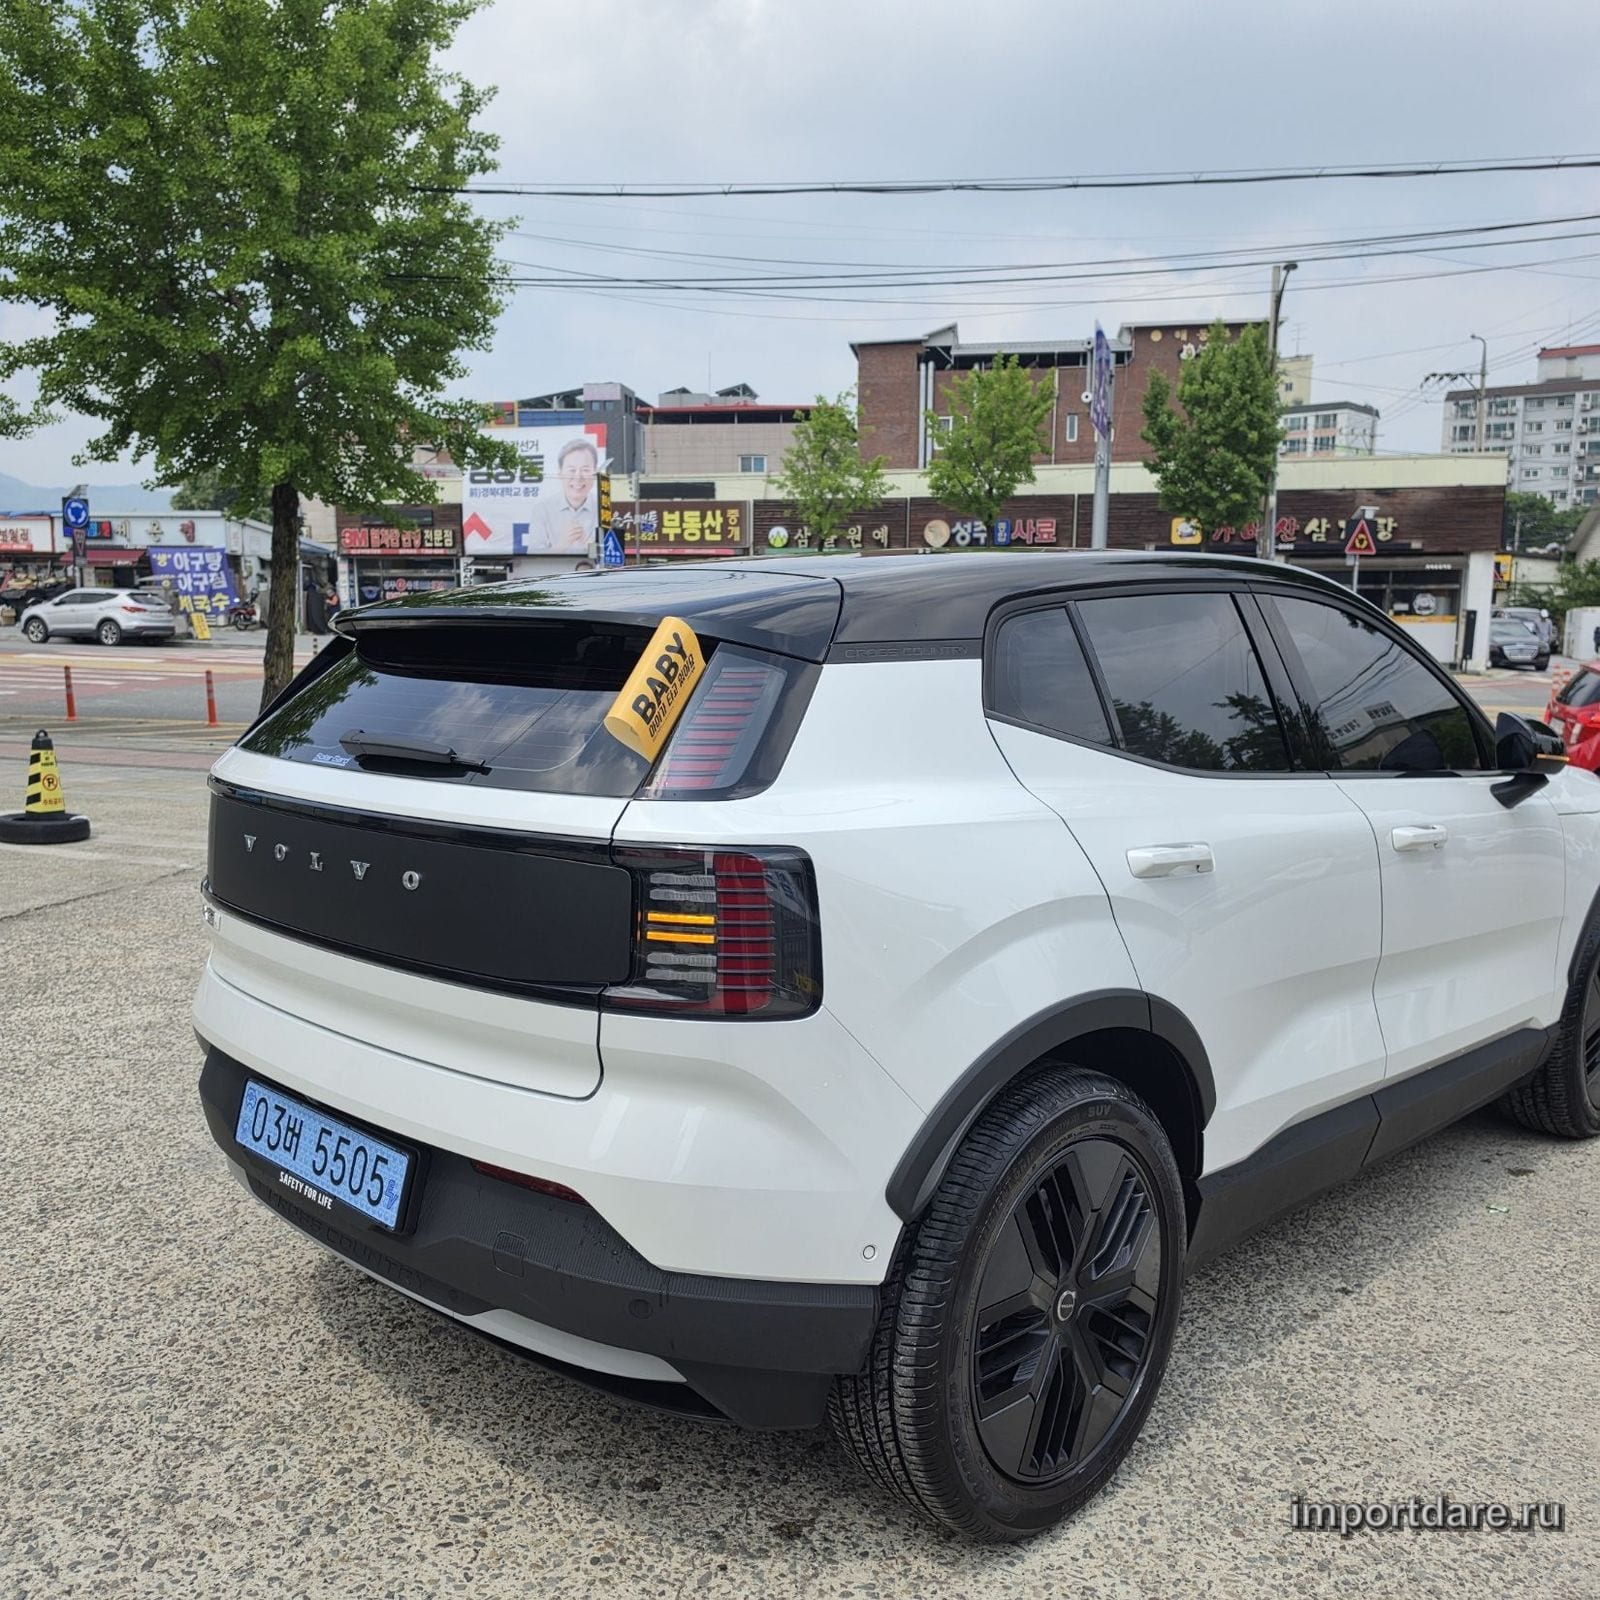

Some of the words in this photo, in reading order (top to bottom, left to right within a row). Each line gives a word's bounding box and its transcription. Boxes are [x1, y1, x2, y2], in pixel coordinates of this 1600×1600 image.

[340, 528, 369, 549] 3M
[662, 510, 723, 541] 부동산
[727, 509, 740, 541] 중개
[951, 521, 987, 545] 성주
[1011, 519, 1056, 544] 사료
[173, 552, 222, 571] 아구탕
[632, 632, 687, 725] BABY
[244, 834, 421, 891] VOLVO
[251, 1096, 304, 1161] 03버
[312, 1126, 389, 1207] 5505
[279, 1171, 304, 1193] SAFETY
[303, 1185, 319, 1201] FOR
[317, 1192, 333, 1210] LIFE
